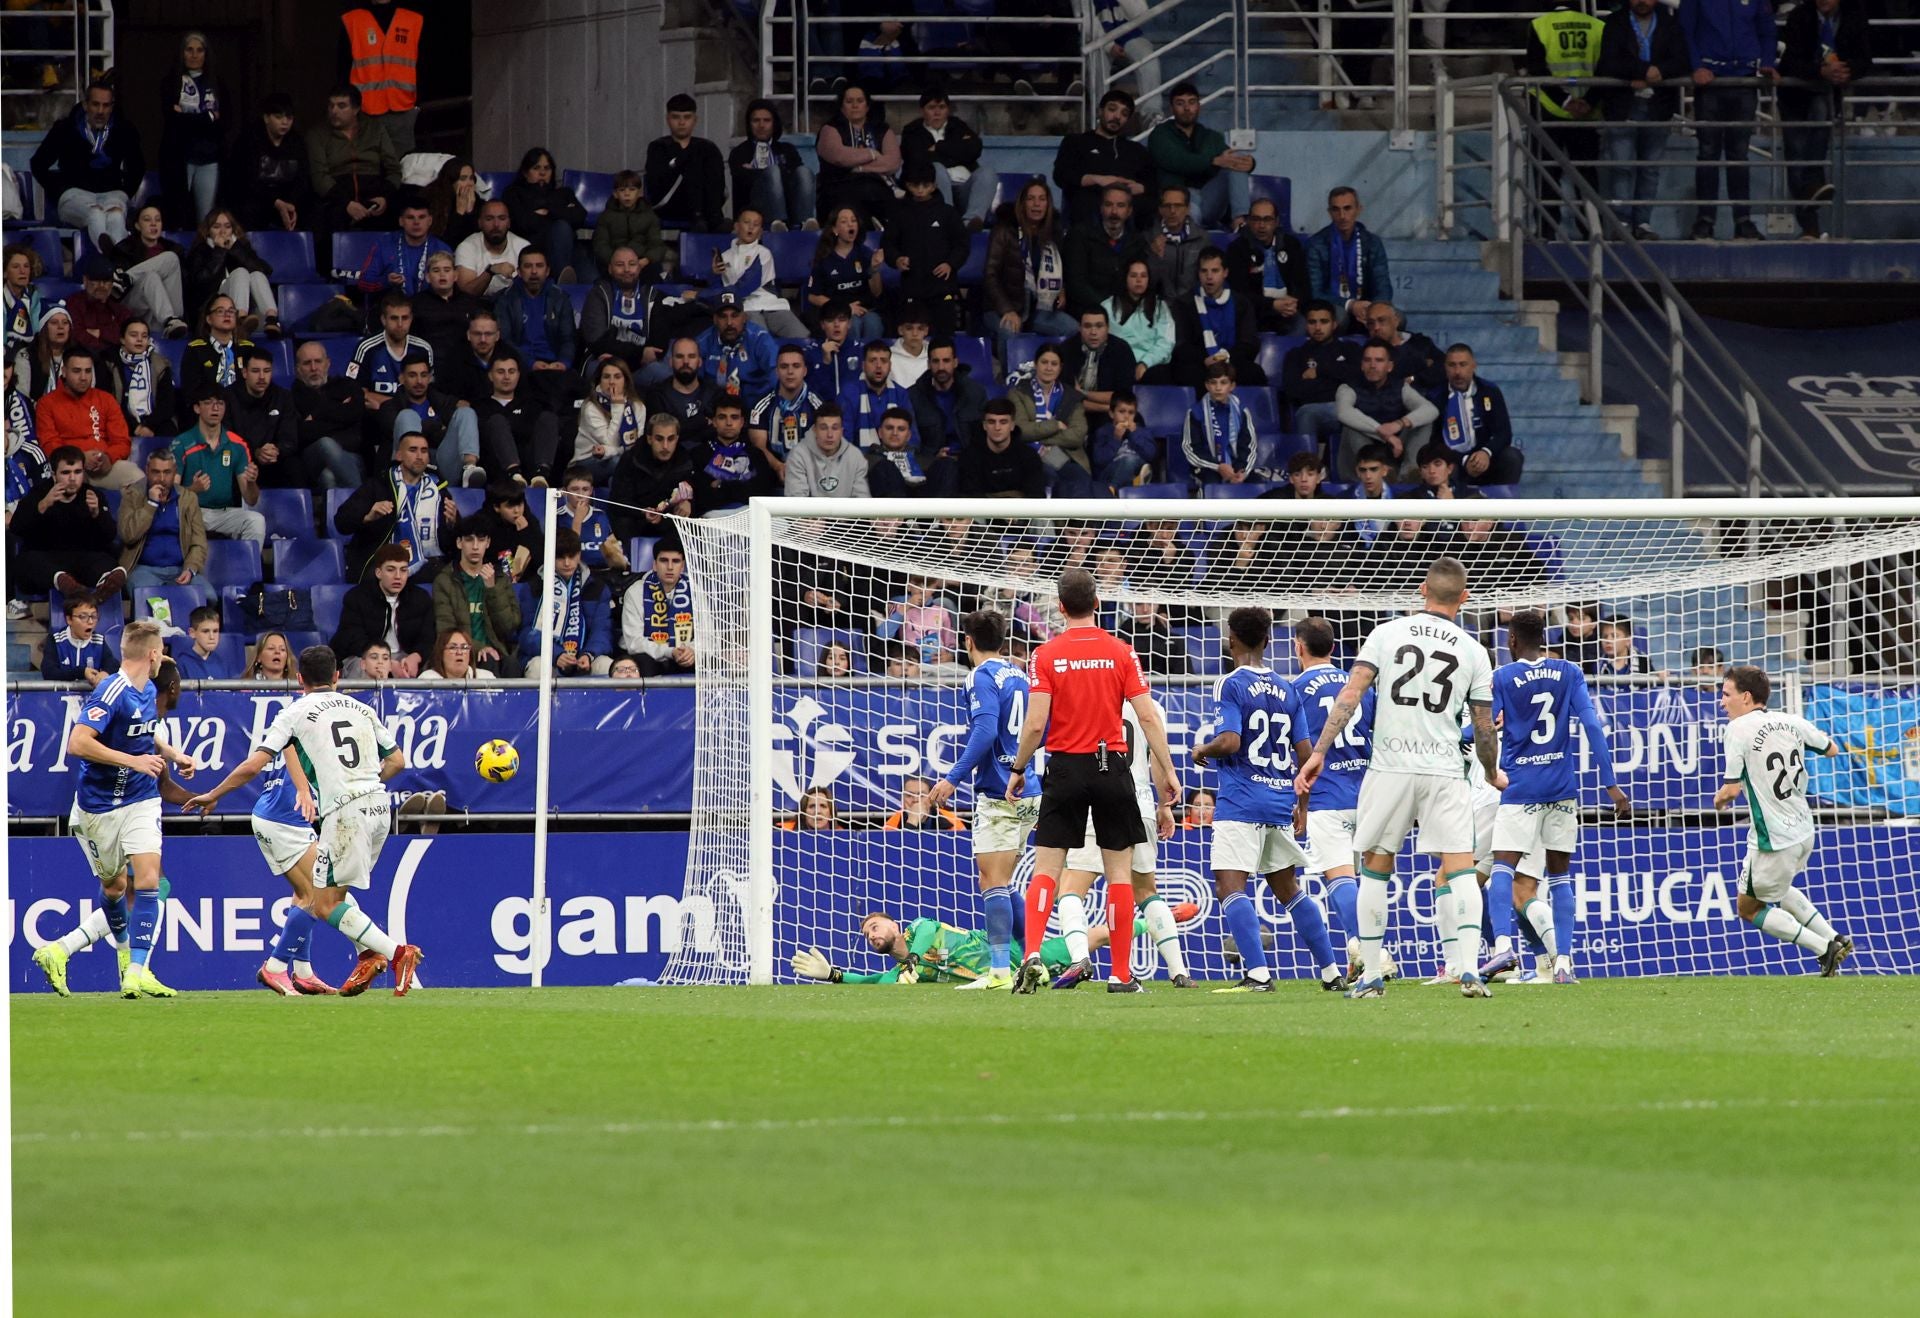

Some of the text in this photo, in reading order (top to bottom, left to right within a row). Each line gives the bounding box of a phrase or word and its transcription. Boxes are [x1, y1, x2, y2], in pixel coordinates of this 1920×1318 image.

[1559, 31, 1587, 49] 013
[375, 381, 396, 394] DI
[650, 583, 668, 628] Real
[1409, 626, 1459, 647] SIELVA
[1069, 659, 1115, 670] WÜRTH
[1303, 675, 1331, 697] DANI
[1390, 644, 1459, 714] 23
[1247, 680, 1287, 701] HASSAN
[1007, 690, 1025, 744] 4
[1247, 708, 1292, 771] 23
[1319, 695, 1366, 749] 12
[1530, 691, 1556, 745] 3
[330, 720, 361, 769] 5
[89, 840, 99, 859] 9
[1574, 872, 1736, 922] HUCA
[490, 895, 719, 975] gam
